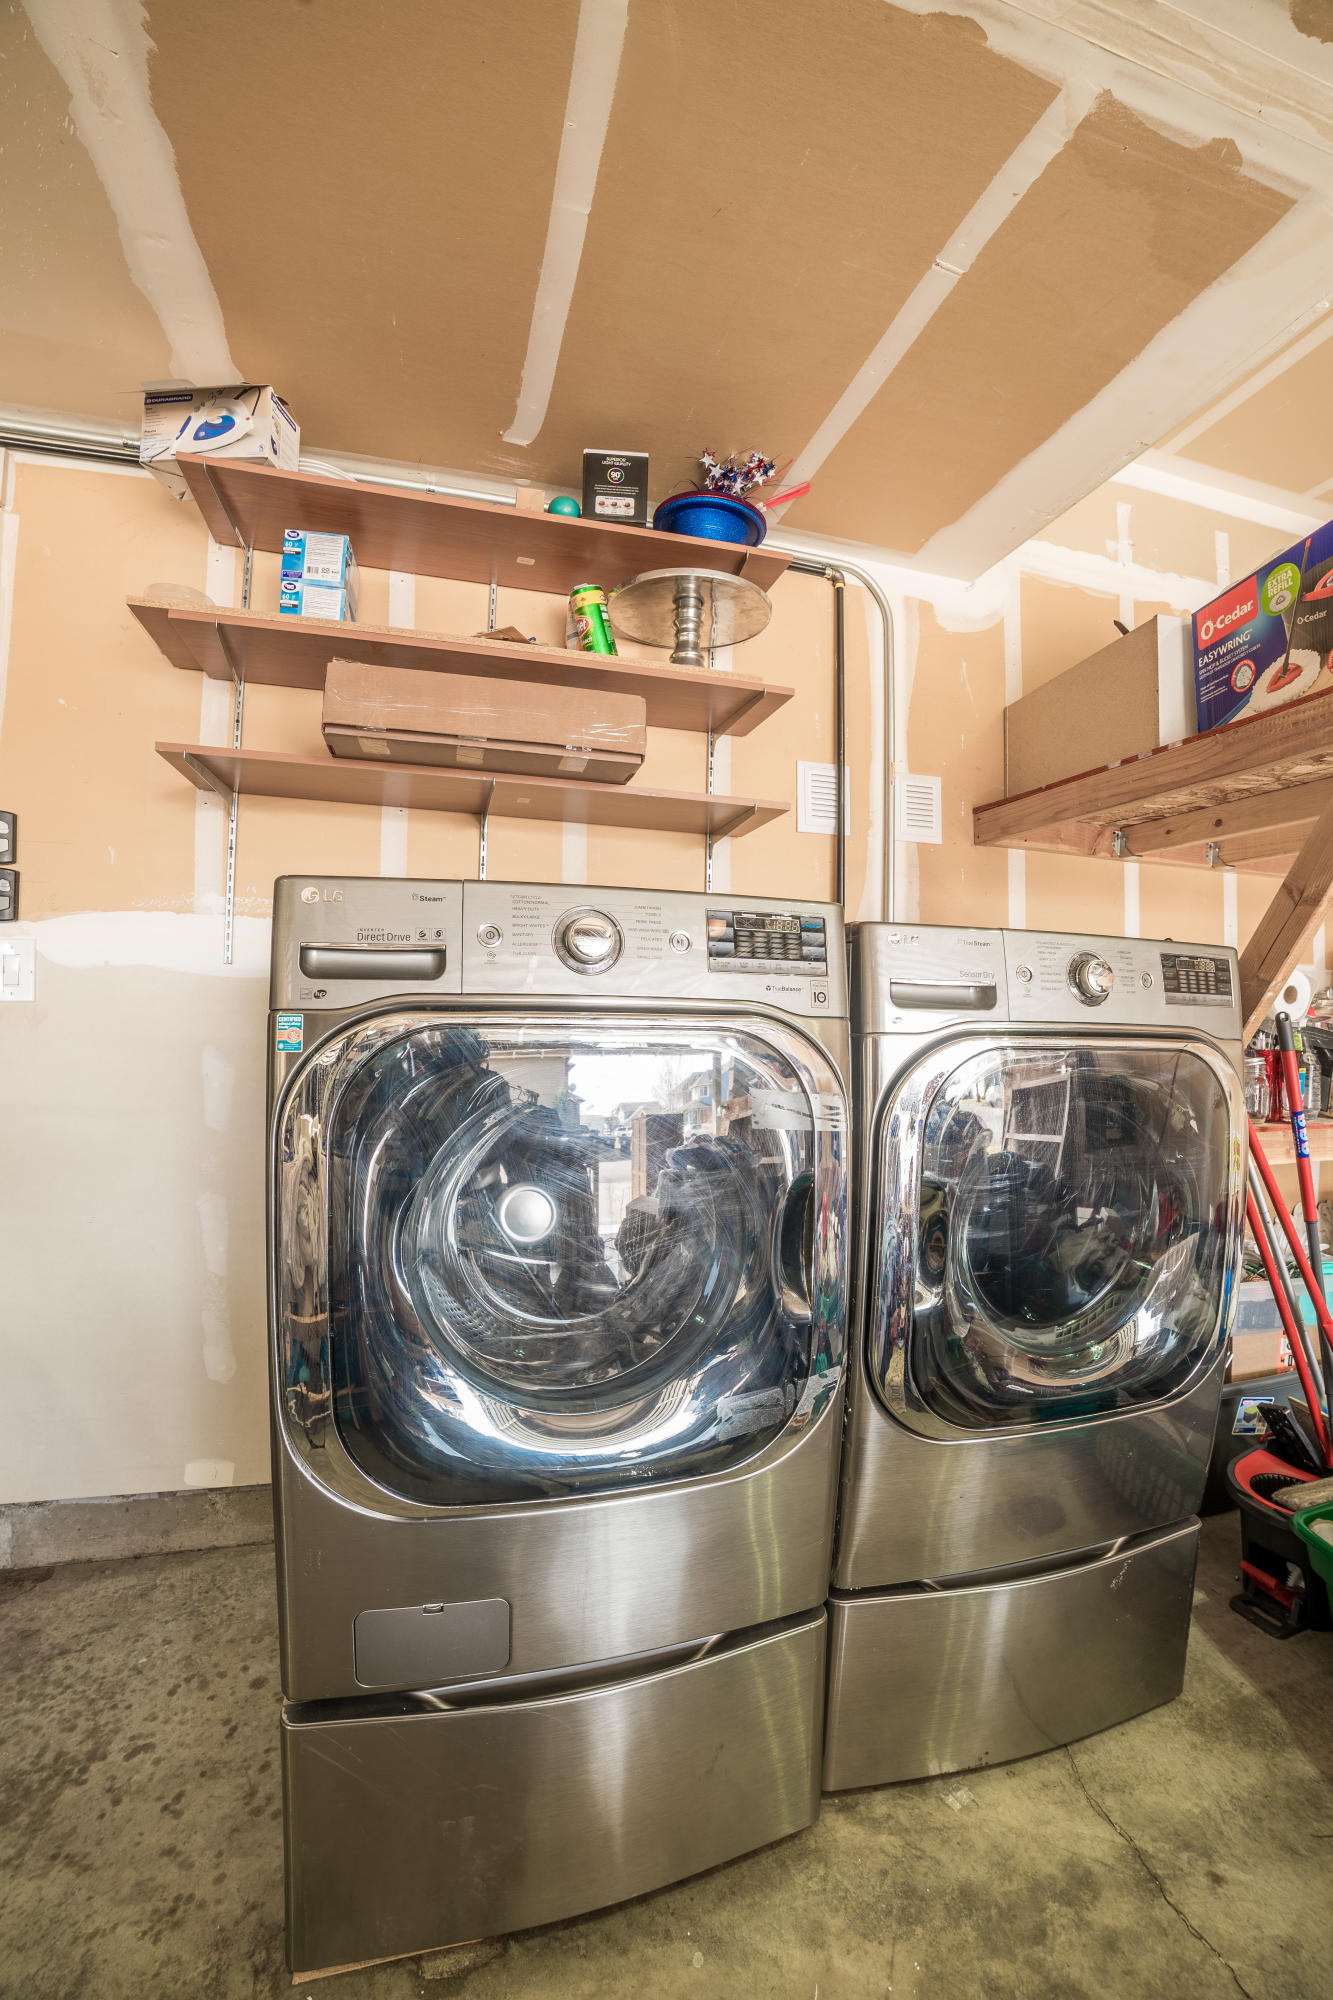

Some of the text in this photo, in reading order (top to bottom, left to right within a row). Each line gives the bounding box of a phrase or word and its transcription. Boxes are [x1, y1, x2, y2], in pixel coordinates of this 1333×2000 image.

[1267, 569, 1292, 588] EXTRA
[1267, 580, 1293, 598] REFILL
[1200, 600, 1253, 640] O-Cedar
[1207, 662, 1216, 672] MOP
[1220, 654, 1233, 664] BUCKET
[1234, 644, 1248, 656] SYSTEM
[322, 888, 344, 903] LG
[357, 932, 411, 942] Direct Drive
[813, 992, 827, 1003] 10
